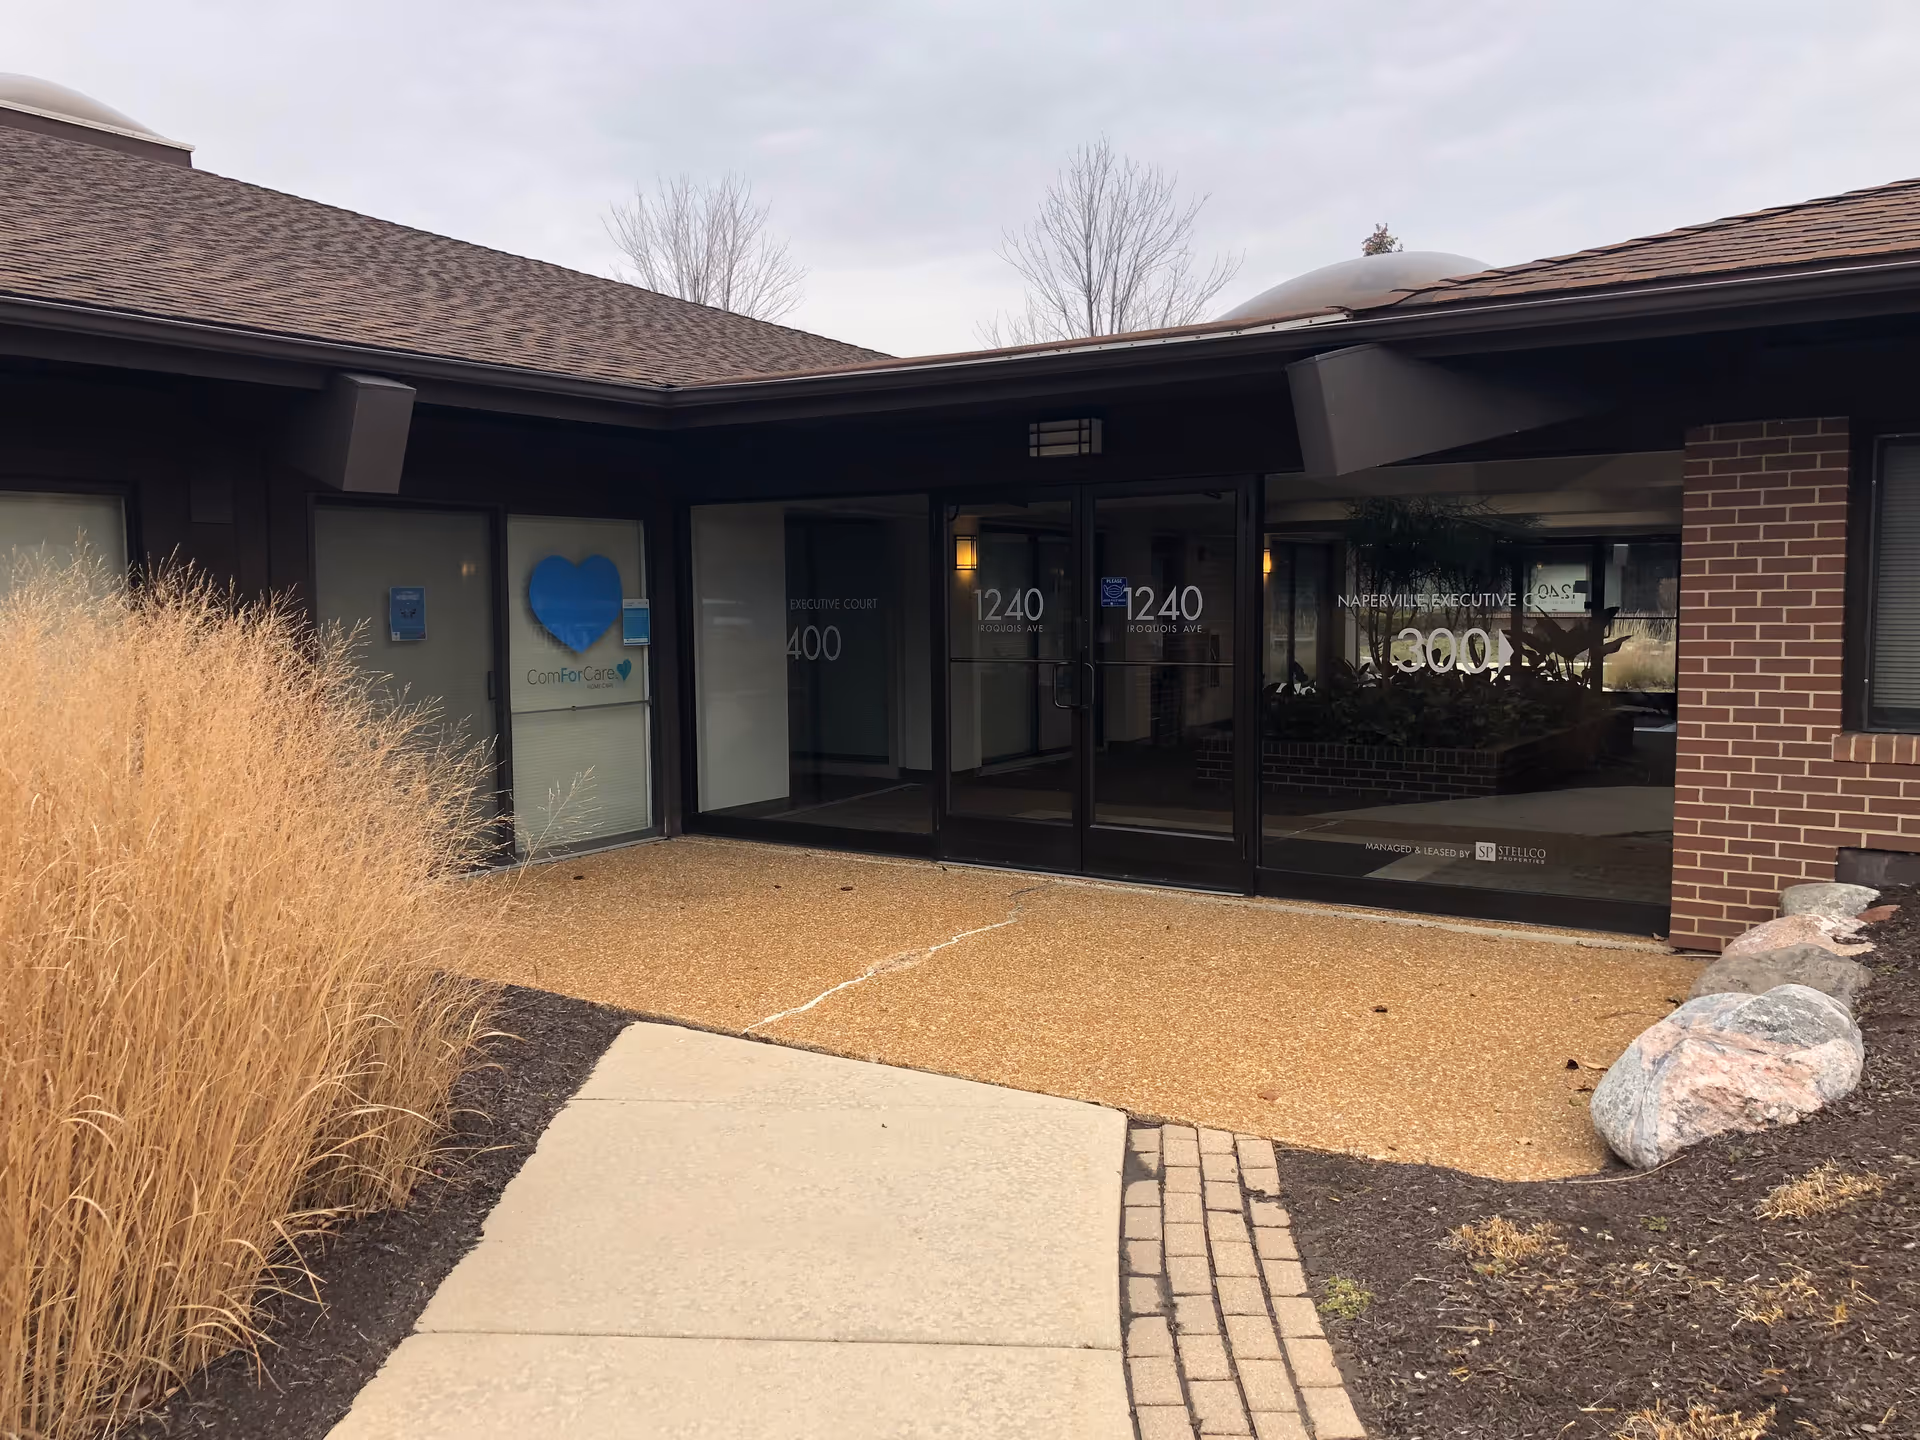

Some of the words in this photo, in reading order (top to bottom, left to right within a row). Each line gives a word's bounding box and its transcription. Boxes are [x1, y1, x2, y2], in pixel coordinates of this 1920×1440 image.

[790, 598, 840, 610] EXECUTIVE
[843, 598, 878, 610] COURT
[973, 588, 1044, 621] 1240
[1123, 585, 1203, 621] 1240
[1338, 593, 1425, 608] NAPERVILLE
[1431, 592, 1516, 608] EXECUTIVE
[977, 624, 1022, 633] IROQUOIS
[1026, 624, 1044, 633] AVE
[1127, 624, 1177, 633] IROQUOIS
[1182, 624, 1202, 633] AVE
[785, 625, 842, 661] 400
[1396, 627, 1491, 674] 300
[527, 665, 616, 686] ComForCare
[1365, 842, 1412, 854] MANAGED
[1414, 846, 1421, 854] &
[1424, 847, 1457, 858] LEASED
[1459, 850, 1471, 858] BY
[1478, 845, 1494, 859] SP
[1498, 845, 1546, 859] STELLCO
[1498, 856, 1545, 865] PROPERTIES
